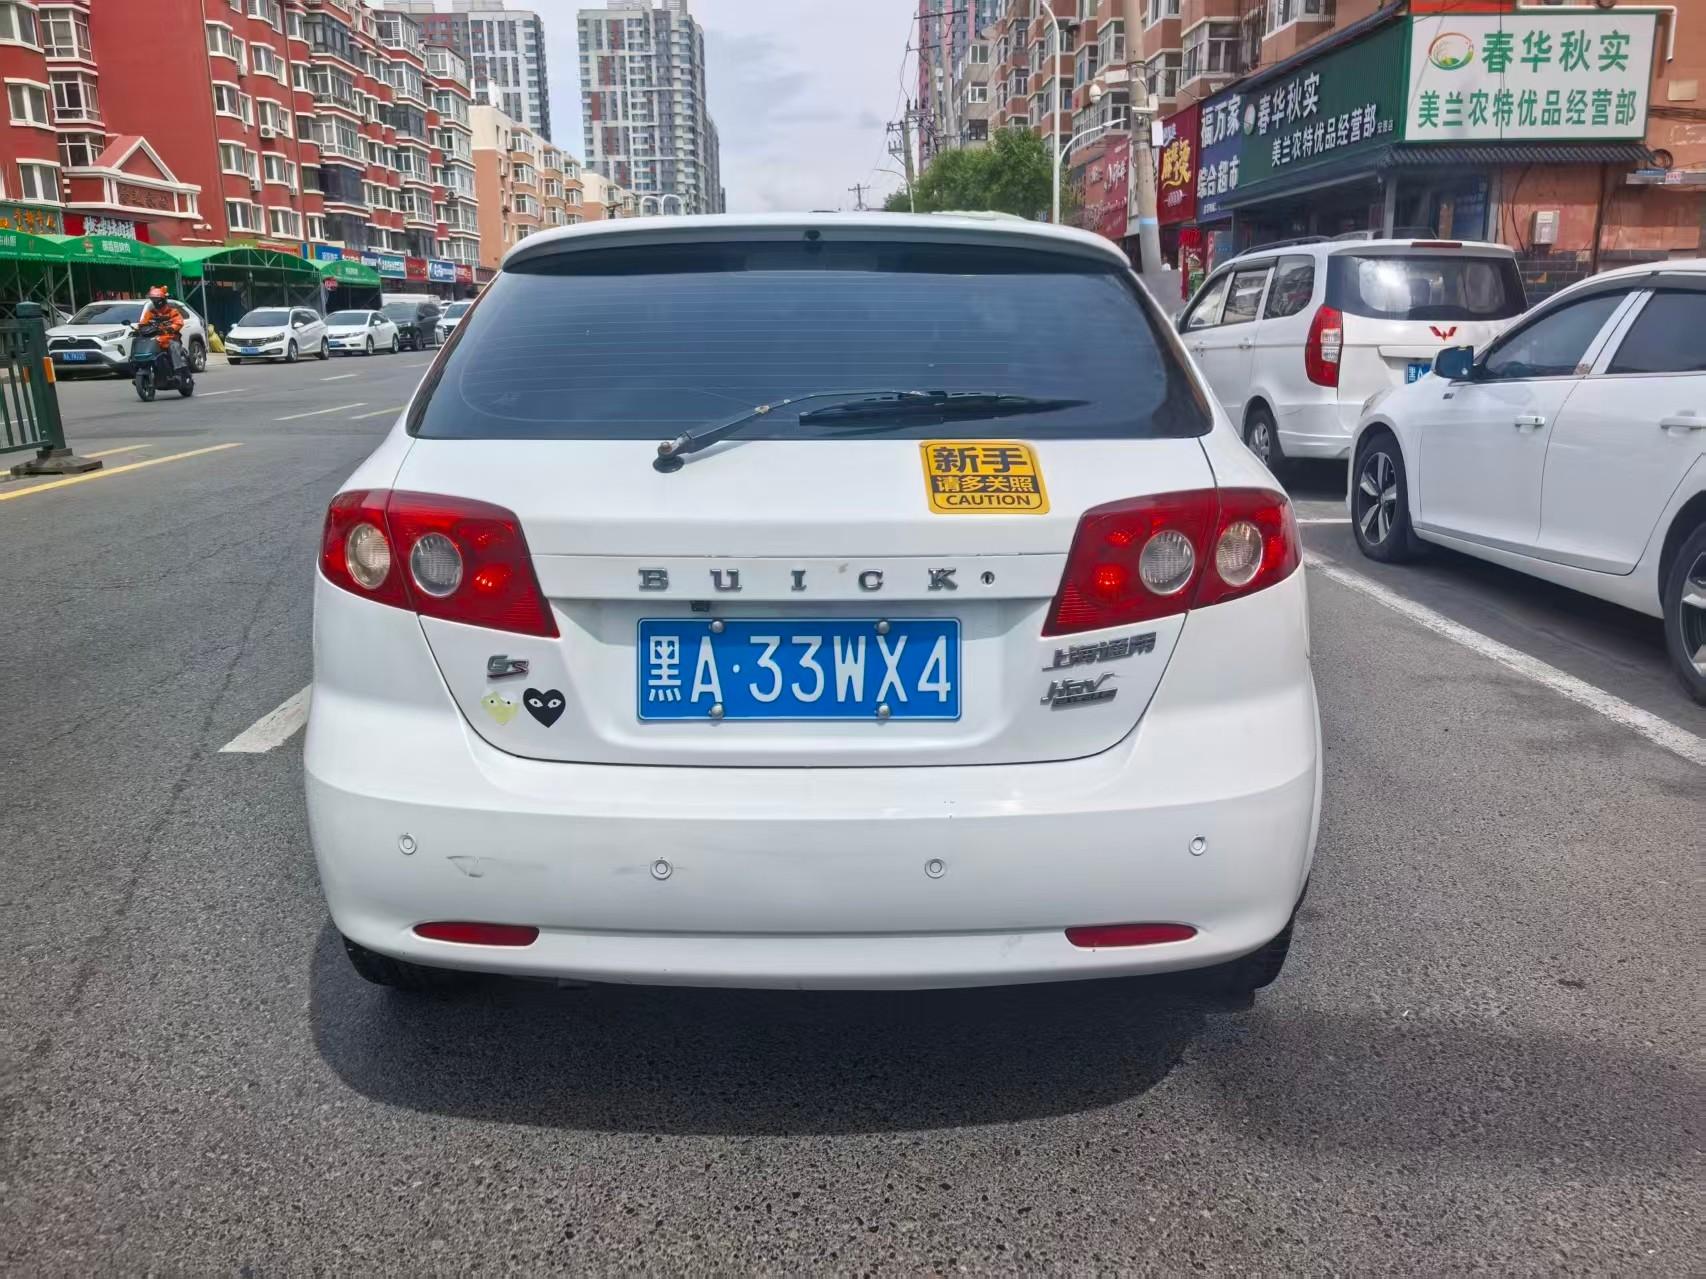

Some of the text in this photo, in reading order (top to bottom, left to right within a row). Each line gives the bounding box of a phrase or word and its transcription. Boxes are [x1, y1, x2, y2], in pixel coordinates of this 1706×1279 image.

[1481, 30, 1631, 73] 春华秋实
[1201, 94, 1241, 148] 福万家
[1257, 72, 1320, 136] 春华秋实
[1418, 89, 1637, 129] 美兰农特优品经营部
[1271, 103, 1377, 168] 美兰农特优品经营部
[1197, 155, 1241, 199] 综合超市
[933, 447, 1028, 473] 新手
[936, 476, 1035, 492] 请多关照
[946, 495, 1031, 505] CAUTION
[638, 568, 958, 592] BUICK
